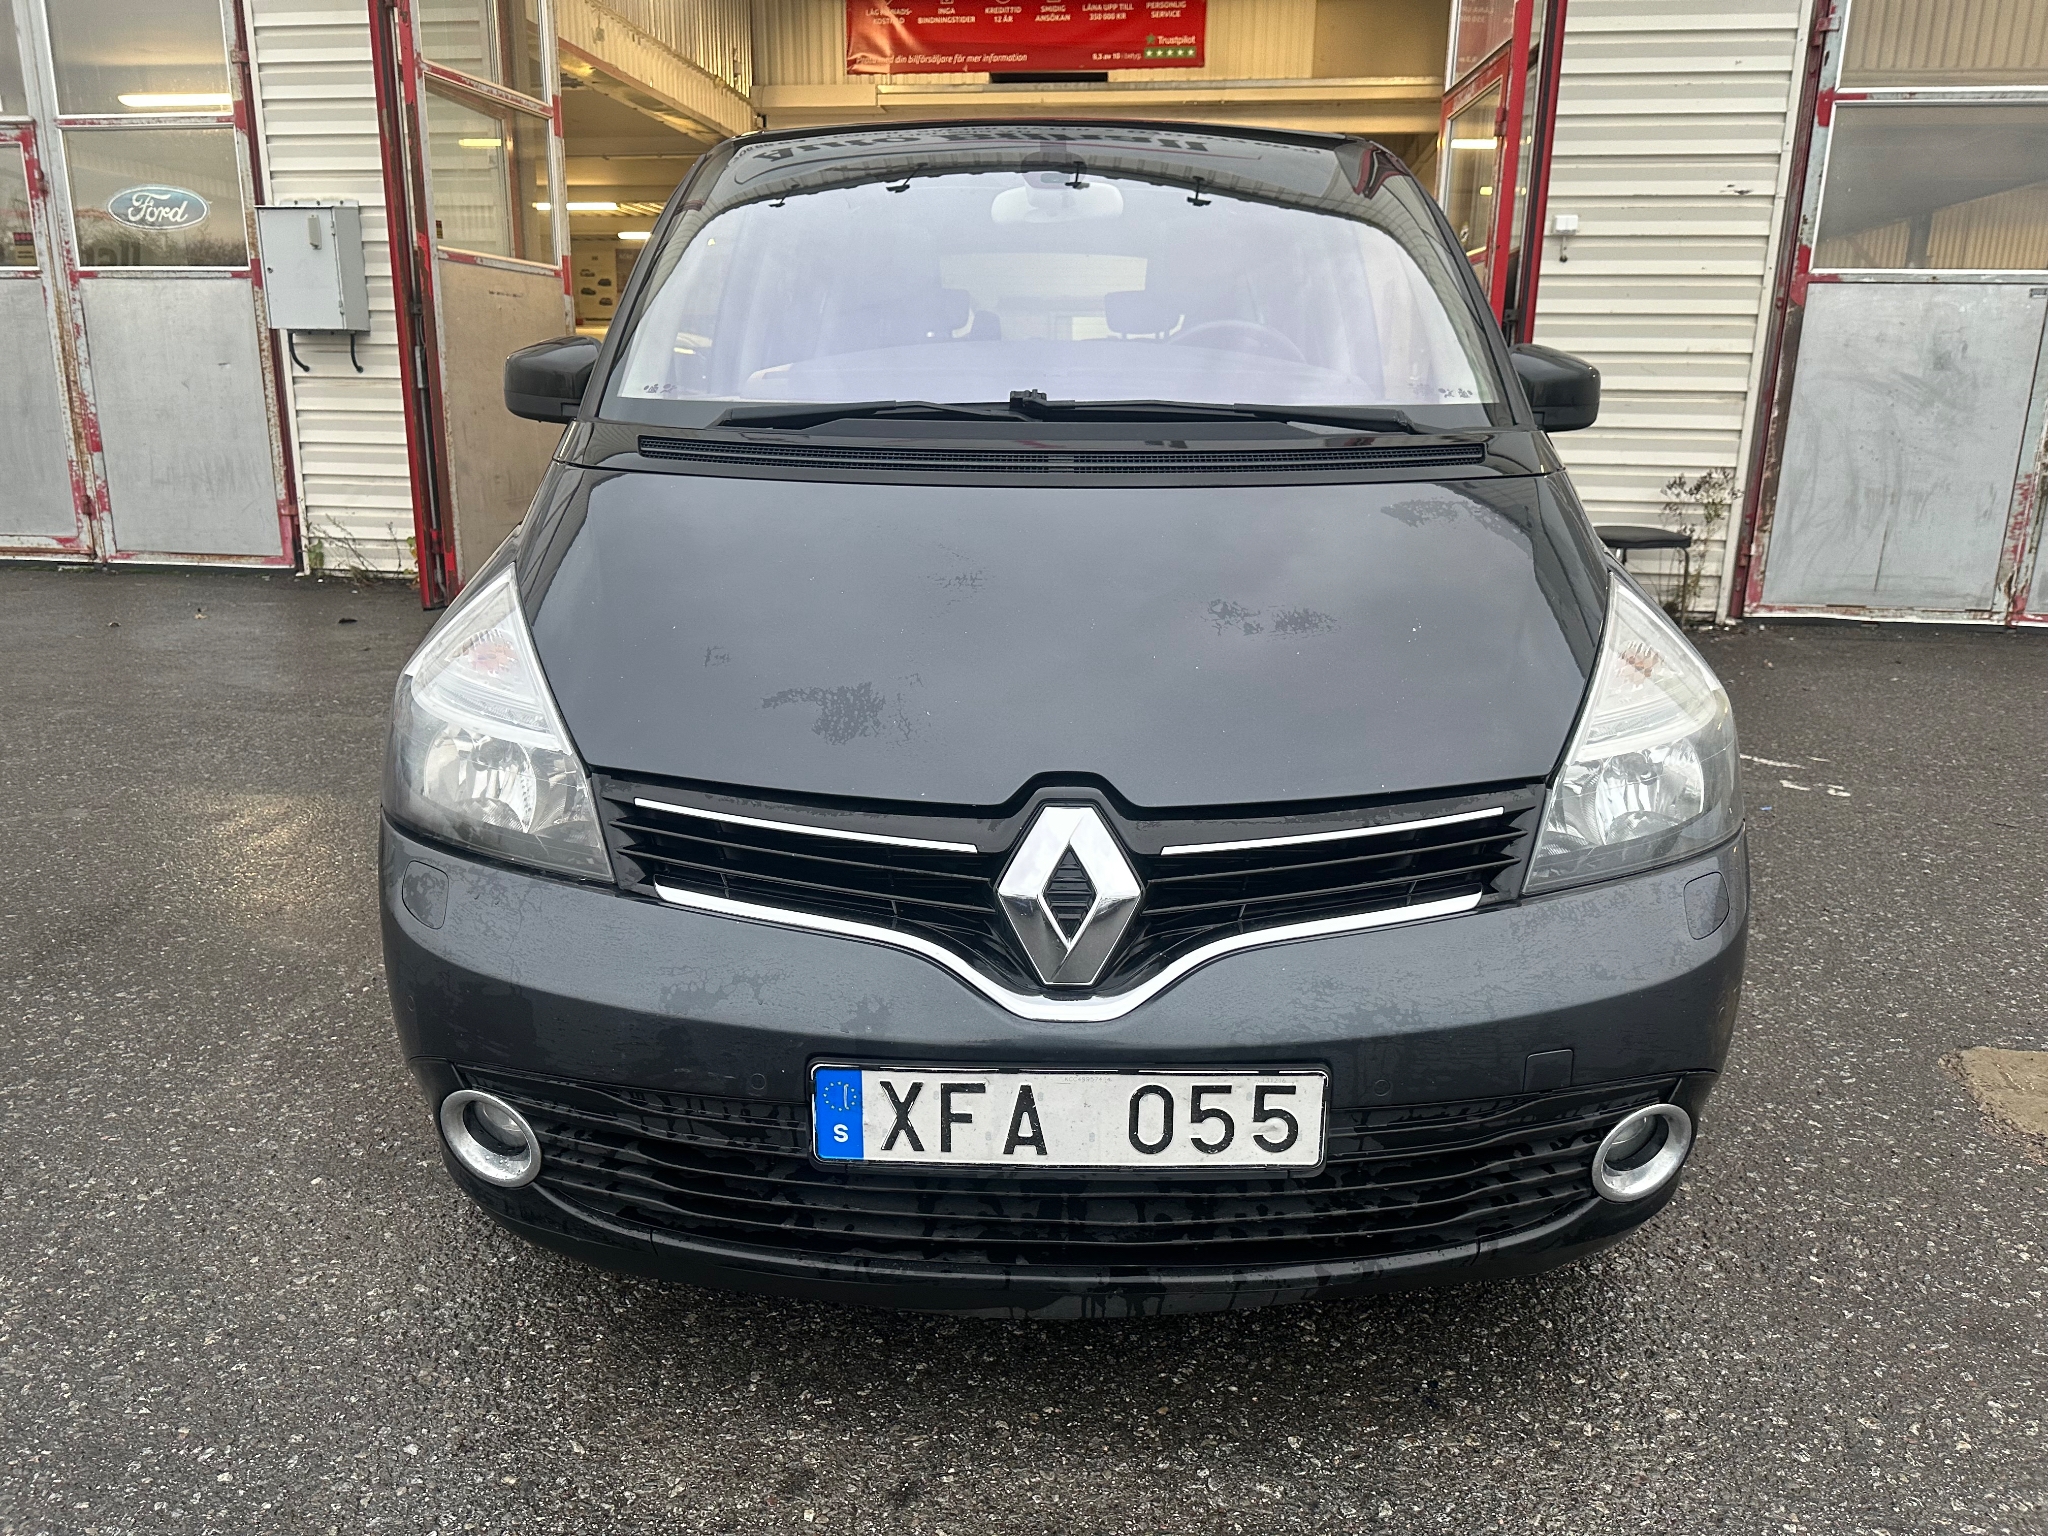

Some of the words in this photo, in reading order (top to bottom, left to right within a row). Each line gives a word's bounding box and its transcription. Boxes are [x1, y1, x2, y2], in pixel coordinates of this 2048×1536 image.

[1082, 3, 1102, 11] LÅNA
[1103, 3, 1118, 11] UPP
[1146, 1, 1186, 9] PERSONLIG
[985, 6, 1021, 14] KREDITTID
[1151, 10, 1181, 18] SERVICE
[918, 16, 975, 24] BINDNINGSTIDER
[1003, 15, 1013, 23] ÅR
[1035, 13, 1071, 22] ANSÖKAN
[1158, 35, 1196, 45] Trustpilot
[908, 55, 953, 65] bilförsäljare
[953, 54, 966, 65] för
[982, 53, 1027, 63] information
[128, 192, 189, 223] Ford
[879, 1081, 1048, 1155] XFA
[1129, 1084, 1298, 1155] 055
[833, 1124, 849, 1143] S
